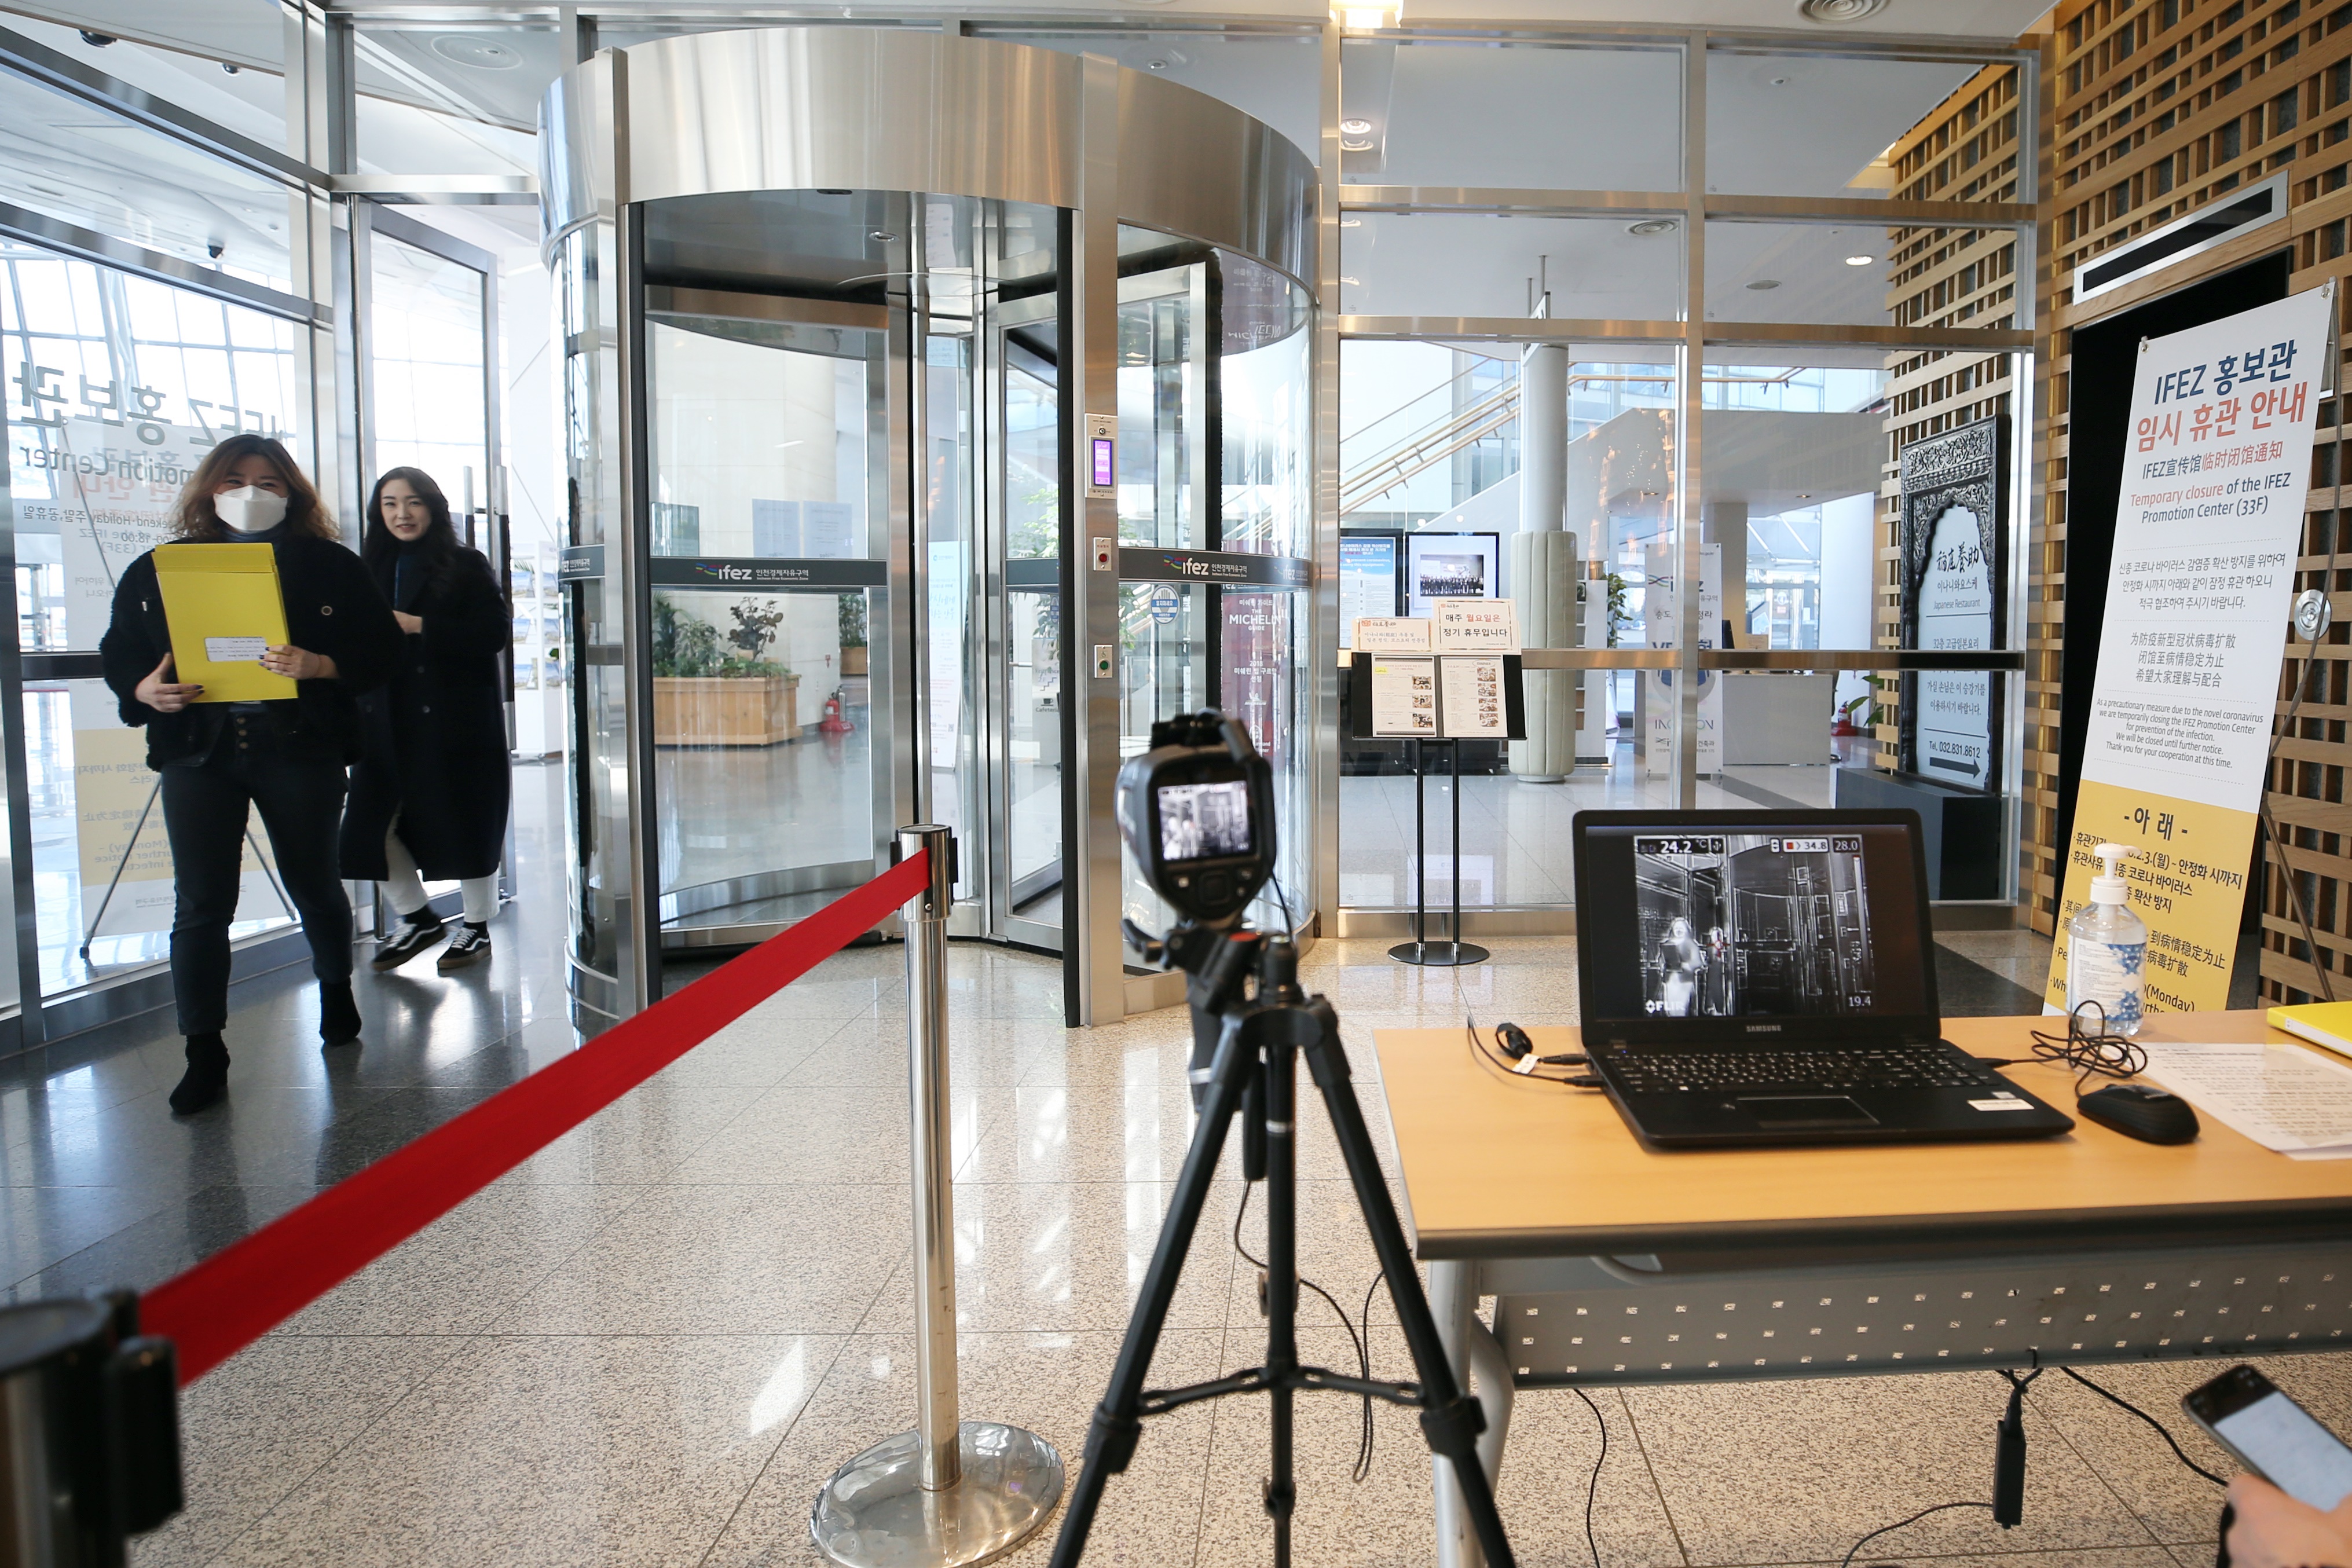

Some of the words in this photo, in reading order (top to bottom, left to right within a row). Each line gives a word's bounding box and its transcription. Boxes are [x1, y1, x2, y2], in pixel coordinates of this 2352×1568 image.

[2155, 364, 2207, 405] IFEZ
[2214, 339, 2298, 396] 홍보관
[2137, 410, 2182, 453] 임시
[2189, 397, 2241, 442] 휴관
[2251, 382, 2307, 430] 안내
[2130, 490, 2182, 508] Temporary
[2185, 485, 2223, 500] closure
[2226, 478, 2240, 494] of
[2242, 477, 2261, 492] the
[2265, 472, 2291, 489] IFEZ
[2142, 506, 2194, 523] Promotion
[2197, 501, 2234, 517] Center
[2236, 495, 2269, 517] (33F)
[719, 564, 752, 580] ifez
[1182, 557, 1209, 576] ifez
[1211, 563, 1247, 573] 인천경제자유구역
[2119, 562, 2132, 575] 신종
[2133, 560, 2155, 573] 코로나
[2156, 559, 2186, 572] 바이러스
[2188, 557, 2211, 571] 감염증
[2212, 556, 2229, 570] 확산
[2230, 554, 2256, 569] 방지를
[2258, 553, 2286, 567] 위하여
[2122, 579, 2144, 592] 안정화
[2144, 579, 2166, 591] 시까지
[2168, 577, 2190, 591] 아래와
[2192, 577, 2207, 591] 같이
[2209, 576, 2226, 590] 잠정
[2227, 576, 2244, 589] 휴관
[2246, 574, 2273, 588] 하오니
[1933, 600, 1954, 611] Japanese
[1955, 599, 1980, 608] Restaurant
[2139, 598, 2153, 610] 적극
[2155, 596, 2184, 610] 협조하여
[2186, 596, 2210, 609] 주시기
[2211, 596, 2246, 609] 바랍니다.
[1229, 614, 1281, 625] MICHELIN
[1446, 614, 1463, 622] 매주
[1467, 614, 1500, 622] 월요일은
[1443, 628, 1460, 637] 정기
[1464, 628, 1507, 637] 휴무입니다
[2130, 632, 2236, 649] 为防疫新型冠状病毒扩散
[1946, 637, 1979, 650] 고급일본요리
[2138, 650, 2224, 668] 闭馆至病情稳定为止
[2135, 668, 2222, 688] 希望大家理解与配合
[1927, 680, 1937, 693] 가실
[1939, 681, 1955, 694] 손님은
[1956, 682, 1962, 694] 이
[1963, 683, 1985, 696] 승강기를
[1930, 699, 1956, 713] 이용하시기
[1958, 702, 1981, 716] 바랍니다.
[2108, 700, 2145, 712] precautionary
[2146, 704, 2170, 713] measure
[2171, 705, 2183, 714] due
[2185, 707, 2191, 715] to
[2192, 707, 2203, 716] the
[2204, 709, 2222, 718] novel
[2223, 711, 2263, 723] coronavirus
[2117, 711, 2149, 723] temporarily
[2150, 715, 2170, 726] closing
[2171, 717, 2181, 726] the
[2182, 718, 2196, 727] IFEZ
[2197, 719, 2230, 731] Promotion
[2232, 723, 2256, 734] Center
[2126, 722, 2134, 731] for
[2135, 724, 2166, 733] prevention
[2167, 727, 2174, 735] of
[2175, 728, 2184, 738] the
[2186, 730, 2215, 741] infection.
[1940, 741, 1980, 759] 032.831.8612
[2116, 732, 2125, 741] We
[2126, 734, 2136, 742] will
[2137, 735, 2144, 743] be
[2145, 737, 2163, 746] closed
[2164, 739, 2178, 748] until
[2179, 740, 2201, 751] further
[2202, 745, 2223, 754] notice.
[2106, 741, 2122, 750] Thank
[2123, 745, 2134, 753] you
[2134, 745, 2143, 753] for
[2144, 749, 2157, 757] your
[2158, 750, 2193, 762] cooperation
[2195, 755, 2201, 763] at
[2203, 756, 2214, 765] this
[2216, 757, 2233, 768] time.
[2134, 808, 2150, 834] 아
[2157, 812, 2174, 841] 래
[1660, 840, 1691, 853] 24.2
[1804, 841, 1827, 850] 34.8
[1835, 840, 1858, 851] 28.0
[2073, 850, 2103, 870] 휴관사유
[2127, 866, 2155, 886] 코로나
[2156, 874, 2193, 896] 바이러스
[2179, 859, 2207, 880] 안정화
[2209, 867, 2243, 890] 시까지
[2134, 888, 2152, 907] 확산
[2153, 896, 2173, 914] 방지
[2151, 930, 2226, 969] 到病情稳定为止
[1655, 1000, 1685, 1011] FLIR
[1849, 995, 1871, 1007] 19.4
